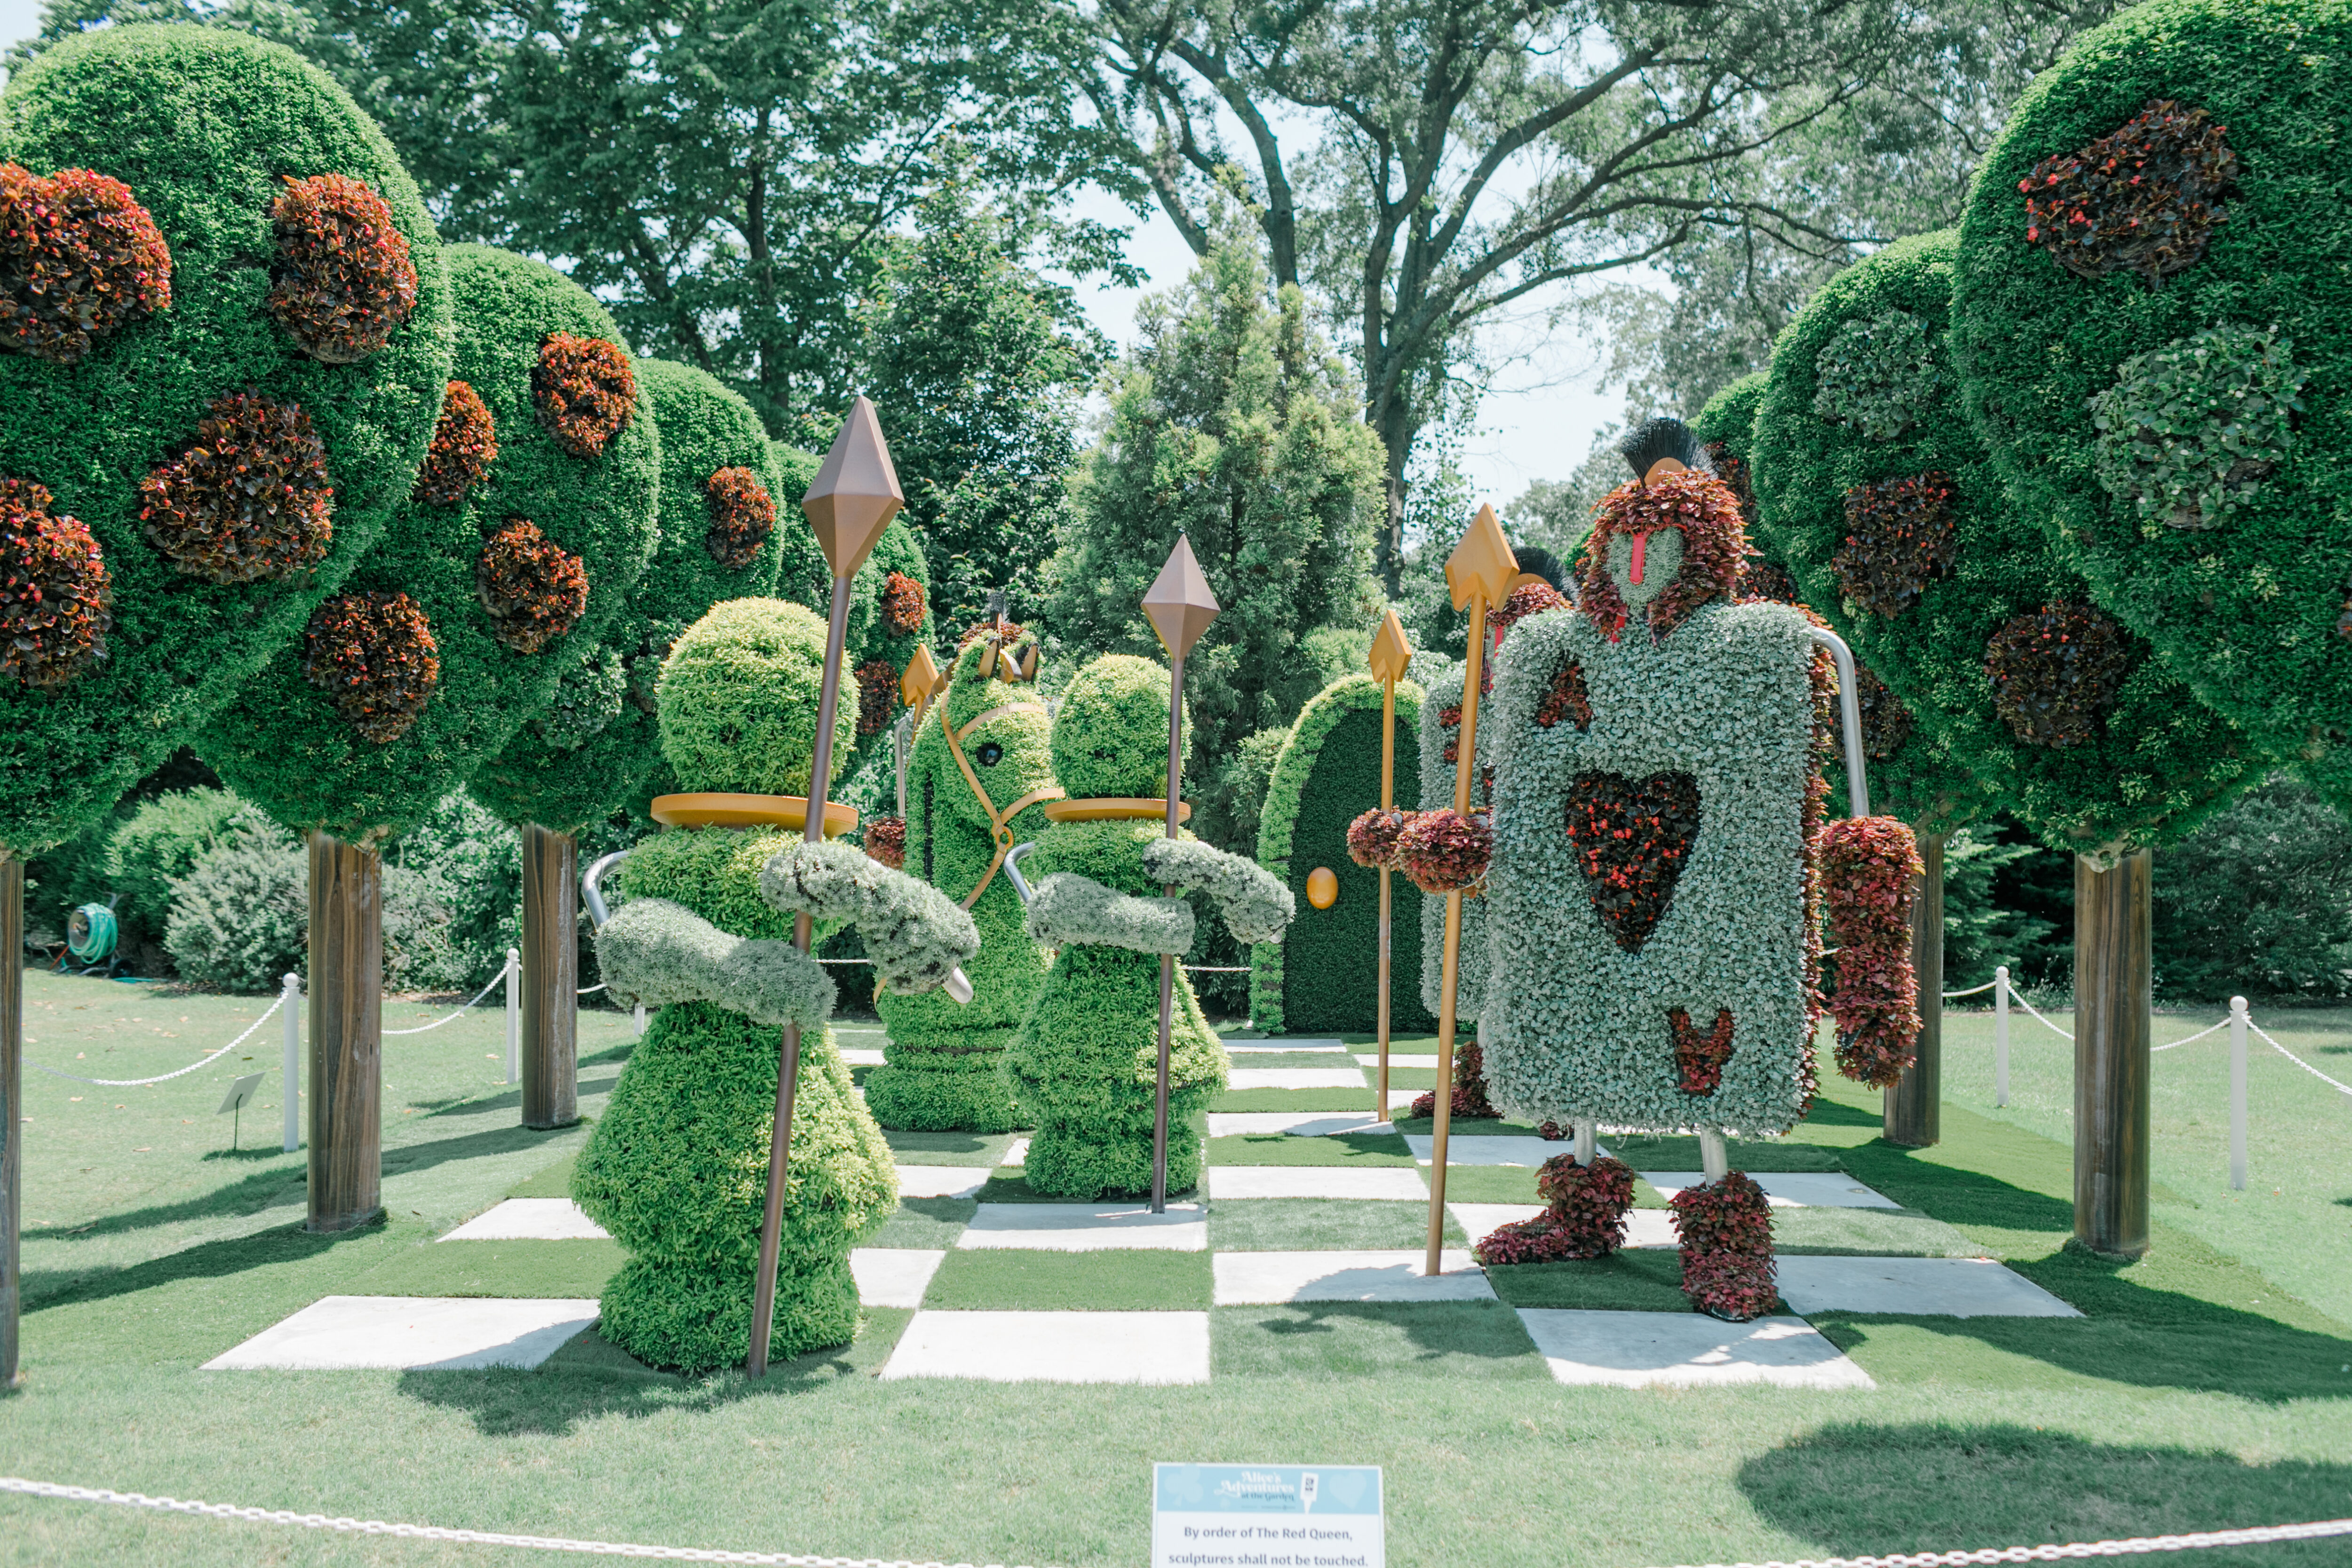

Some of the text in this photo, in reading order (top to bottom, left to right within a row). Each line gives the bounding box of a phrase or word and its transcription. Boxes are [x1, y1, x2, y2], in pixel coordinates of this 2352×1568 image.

[1241, 1471, 1281, 1483] Alice's
[1214, 1479, 1295, 1498] Adventures
[1265, 1493, 1295, 1502] Garden
[1184, 1527, 1352, 1542] By order of The Red Queen,
[1168, 1552, 1368, 1567] sculptures shall not be touched.
